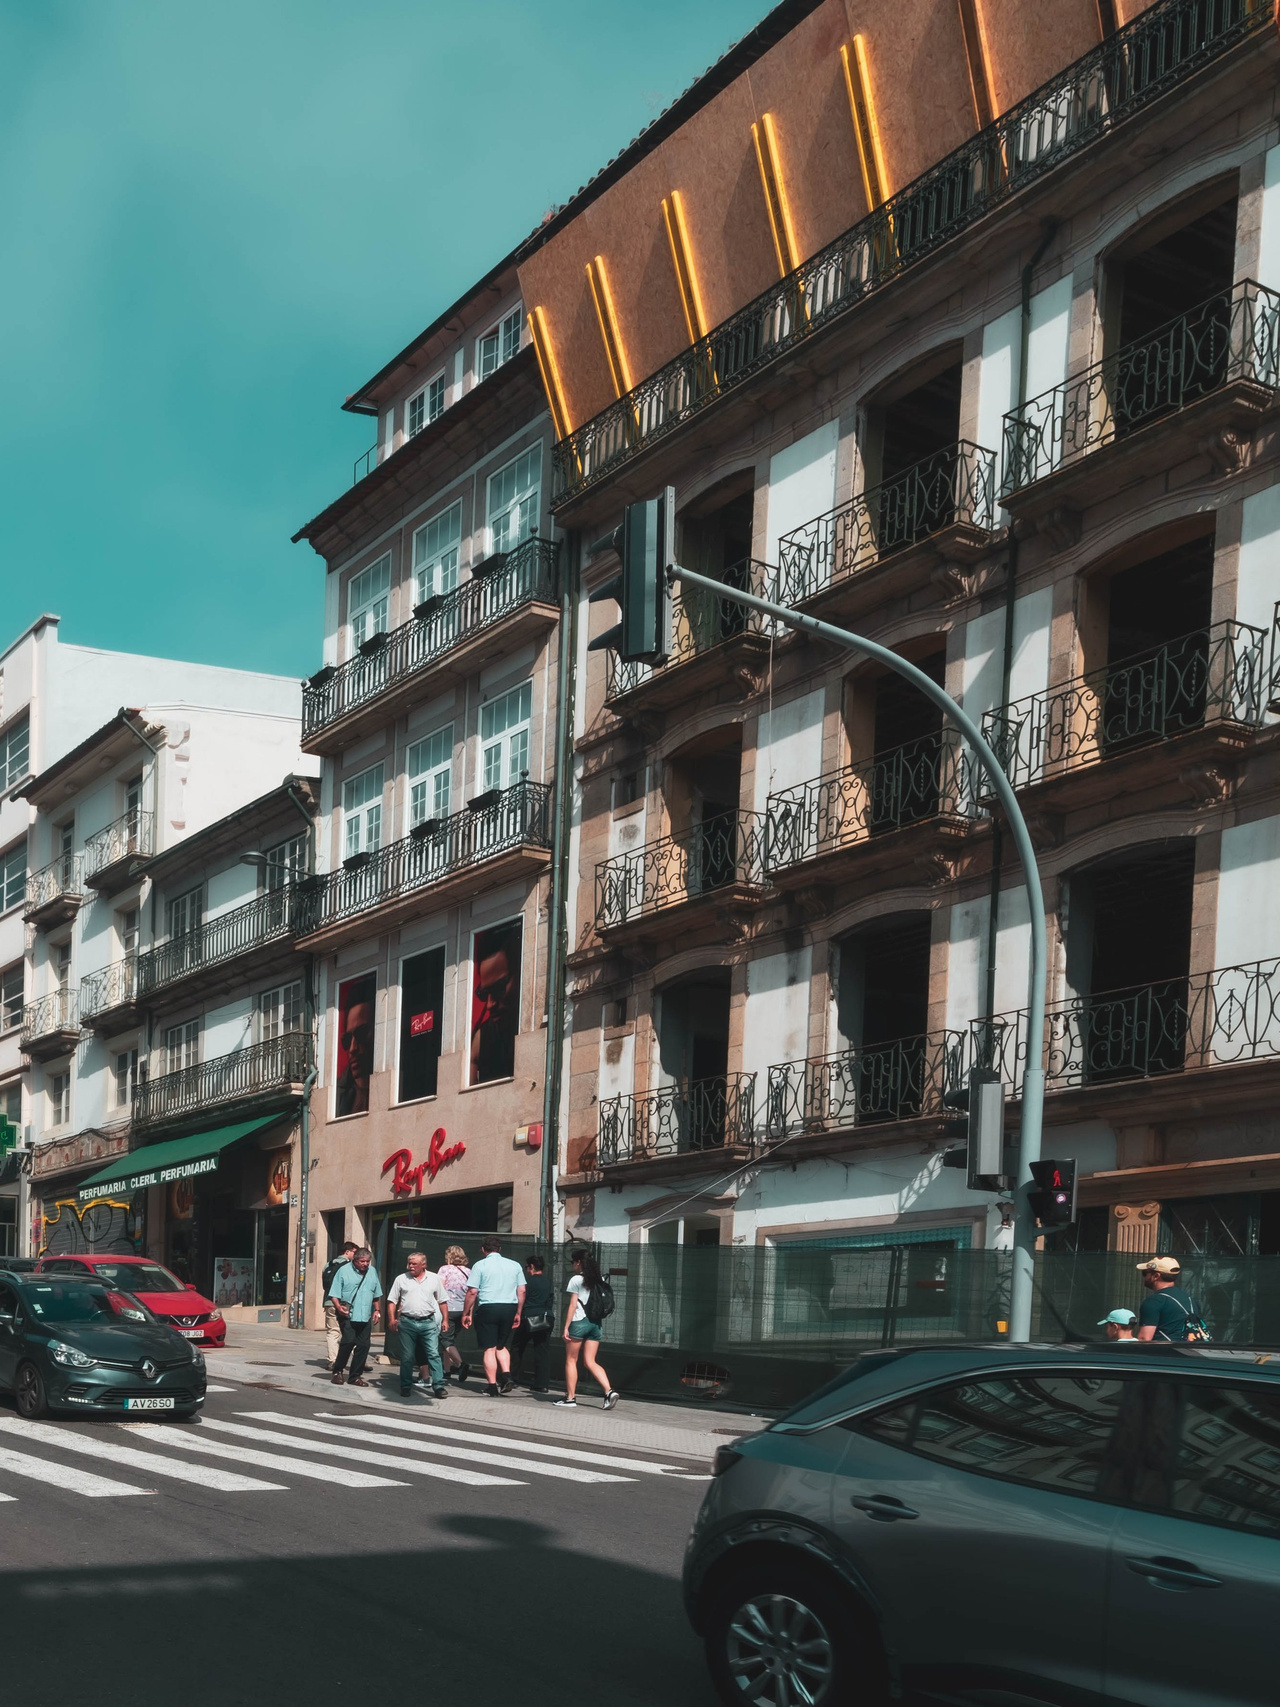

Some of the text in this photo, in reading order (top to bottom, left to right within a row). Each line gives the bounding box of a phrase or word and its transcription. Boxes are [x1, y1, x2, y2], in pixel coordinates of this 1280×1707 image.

[79, 1158, 217, 1200] PERFUMARIA CLERIL PERFUMARIA
[381, 1126, 467, 1195] Ray-Ban
